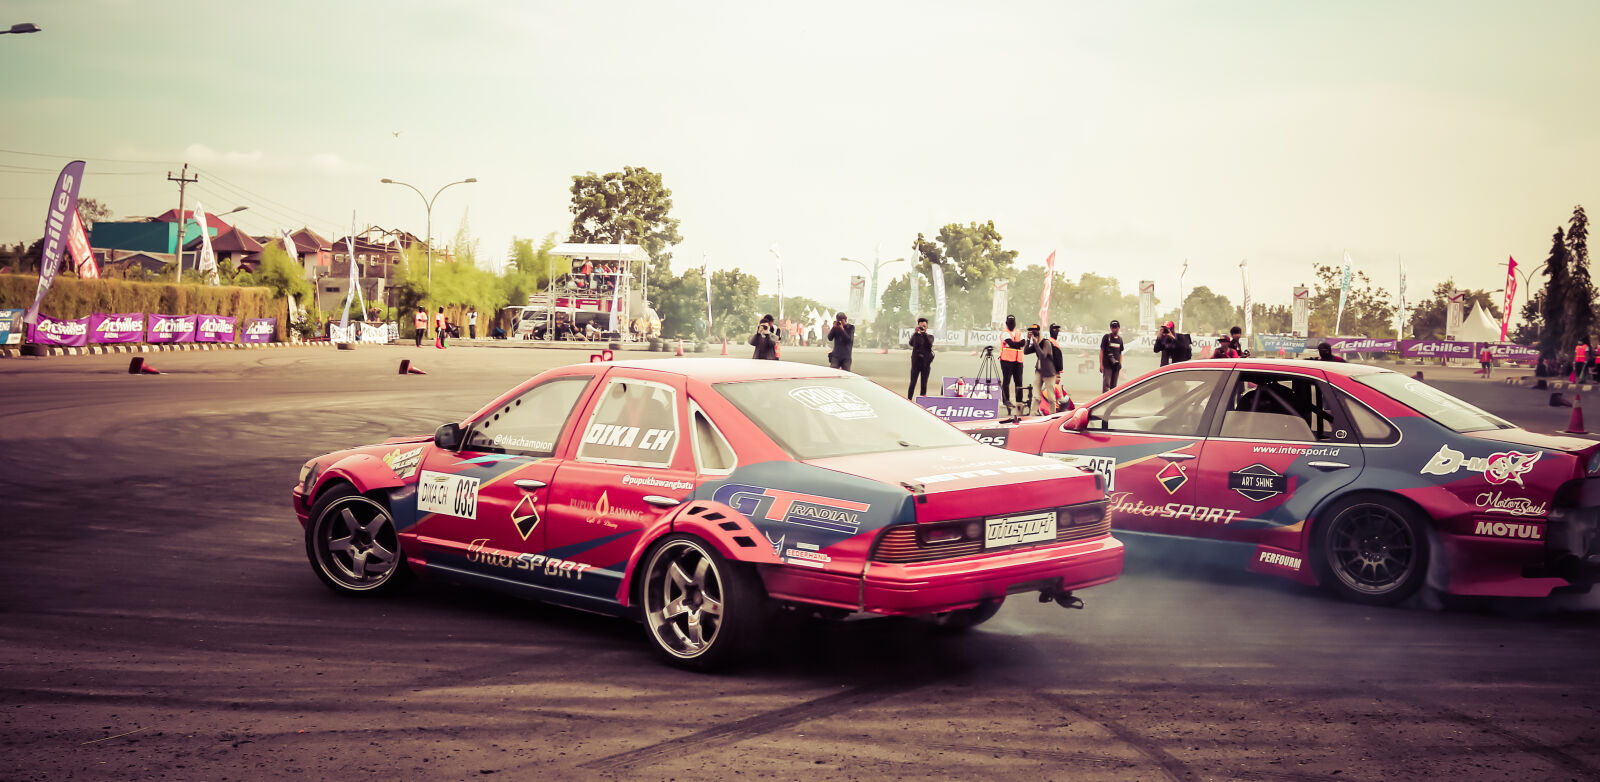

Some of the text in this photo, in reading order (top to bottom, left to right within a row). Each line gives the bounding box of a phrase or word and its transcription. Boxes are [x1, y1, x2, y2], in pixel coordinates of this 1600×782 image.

[37, 319, 87, 336] Achilles
[96, 317, 143, 332] Achilles
[152, 318, 195, 333] Achilles
[200, 318, 234, 334] Achilles
[246, 321, 275, 335] Achilles
[1331, 340, 1393, 349] Achilles
[1408, 342, 1470, 353] Achilles
[493, 434, 554, 450] @dikachampion
[584, 423, 675, 451] DIKA CH
[1253, 445, 1340, 457] www.intersport.id
[622, 473, 694, 490] @pupukbawangbatu
[1241, 475, 1274, 489] ART SHINE
[421, 482, 438, 504] DIKA
[438, 485, 449, 505] CH
[454, 478, 477, 517] 035
[712, 483, 871, 525] GT RADIAL
[609, 505, 645, 521] BAWANG
[1474, 521, 1541, 539] MOTUL
[1259, 551, 1302, 569] PERFOURM
